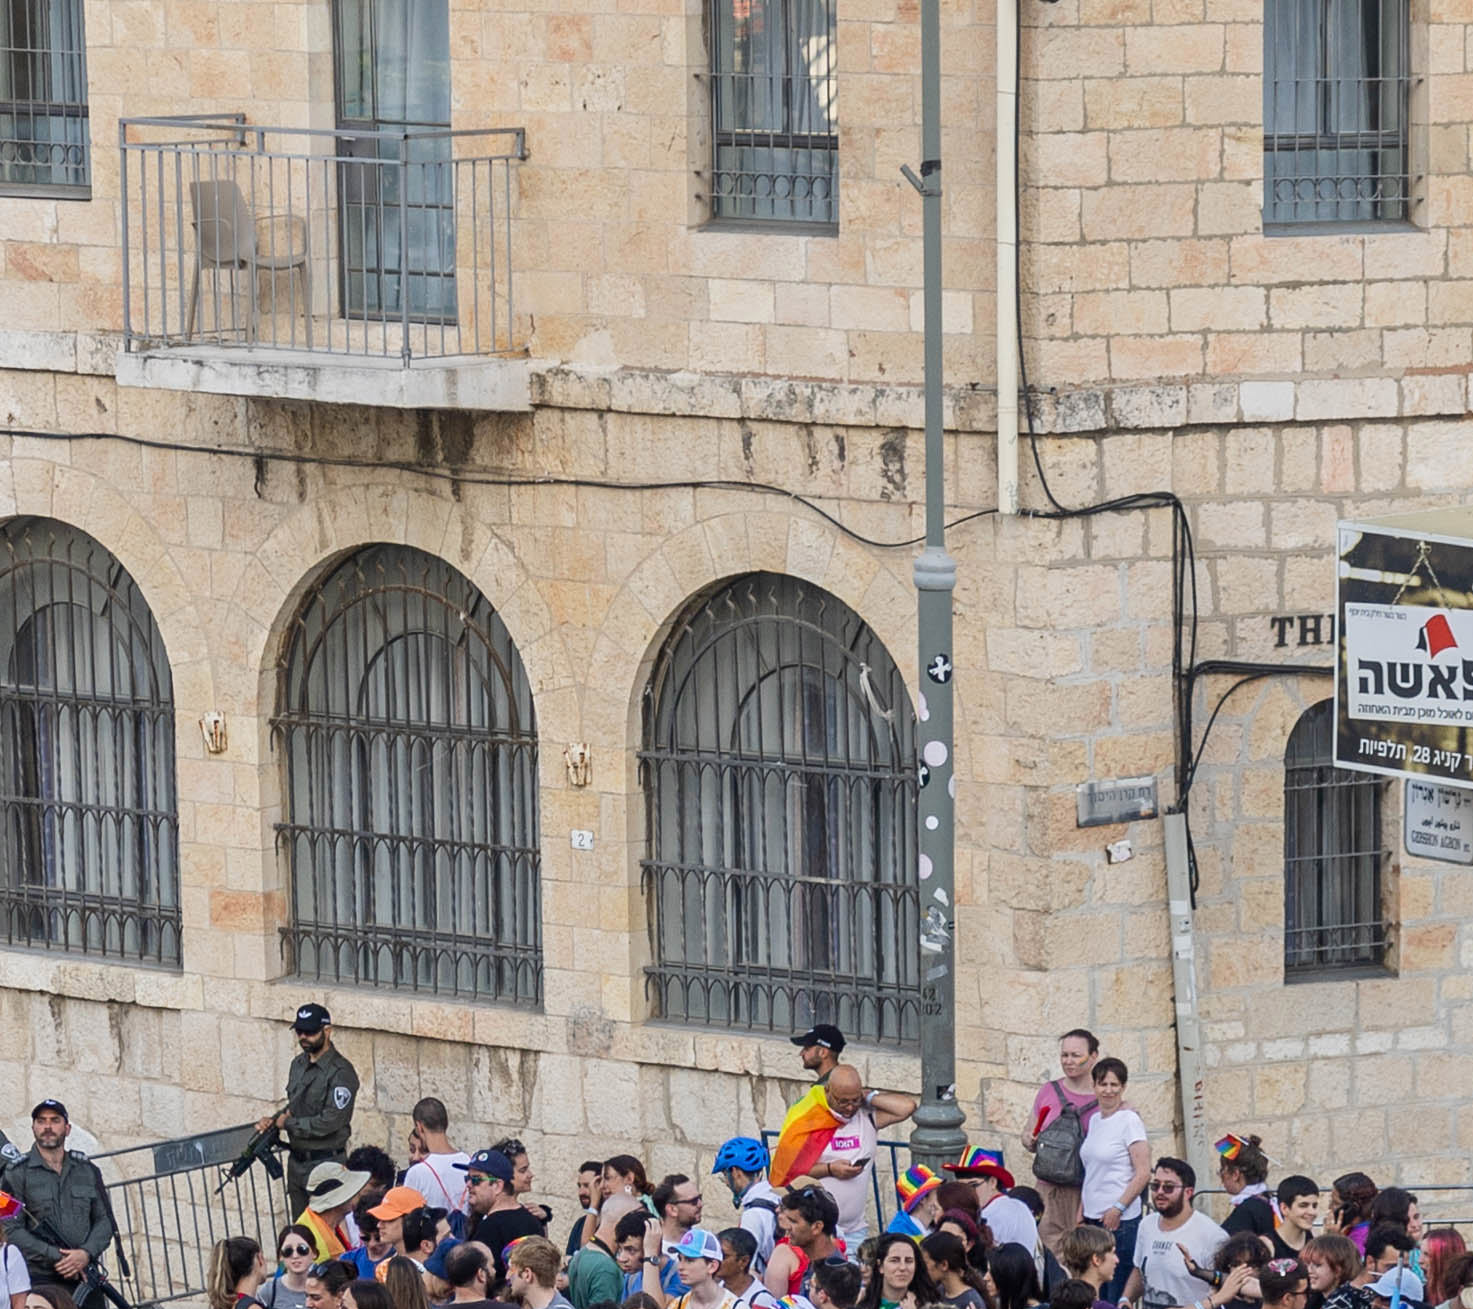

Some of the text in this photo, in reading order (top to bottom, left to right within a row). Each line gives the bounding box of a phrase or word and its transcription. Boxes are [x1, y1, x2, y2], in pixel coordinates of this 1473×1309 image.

[1358, 736, 1407, 762] תלפיות
[1431, 749, 1462, 774] קניג
[577, 832, 585, 848] 2
